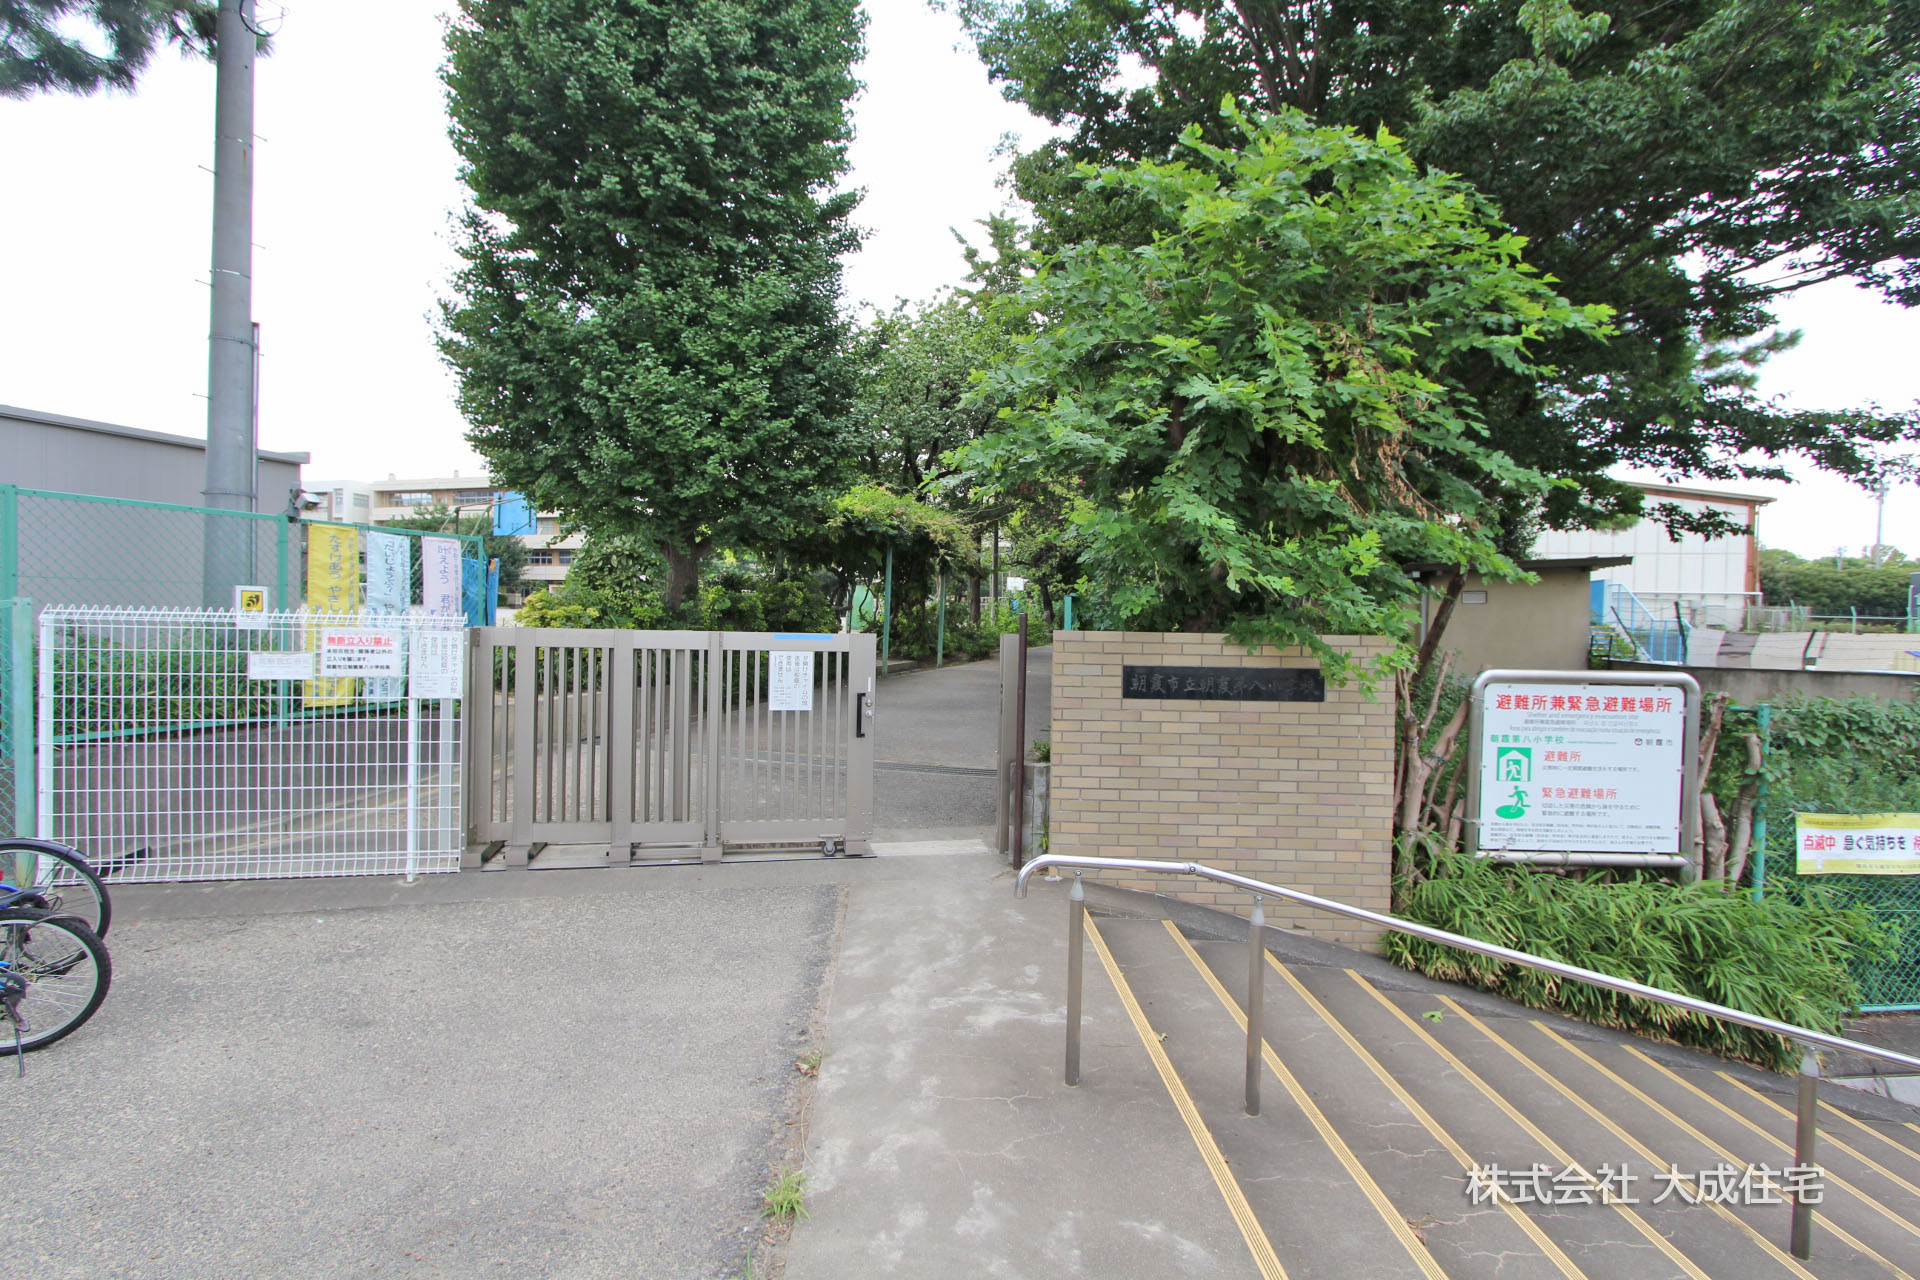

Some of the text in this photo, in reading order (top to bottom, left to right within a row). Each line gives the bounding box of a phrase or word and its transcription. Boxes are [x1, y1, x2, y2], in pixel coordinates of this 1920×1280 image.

[437, 545, 449, 585] 叶えよう
[327, 636, 393, 646] 無断立入り禁止
[1495, 694, 1673, 713] 避難所兼緊急避難場所
[1490, 734, 1565, 744] 朝霞第八小学校
[1543, 751, 1582, 762] 避難所
[1542, 787, 1618, 800] 緊急避難場所
[1804, 834, 1836, 851] 点滅中
